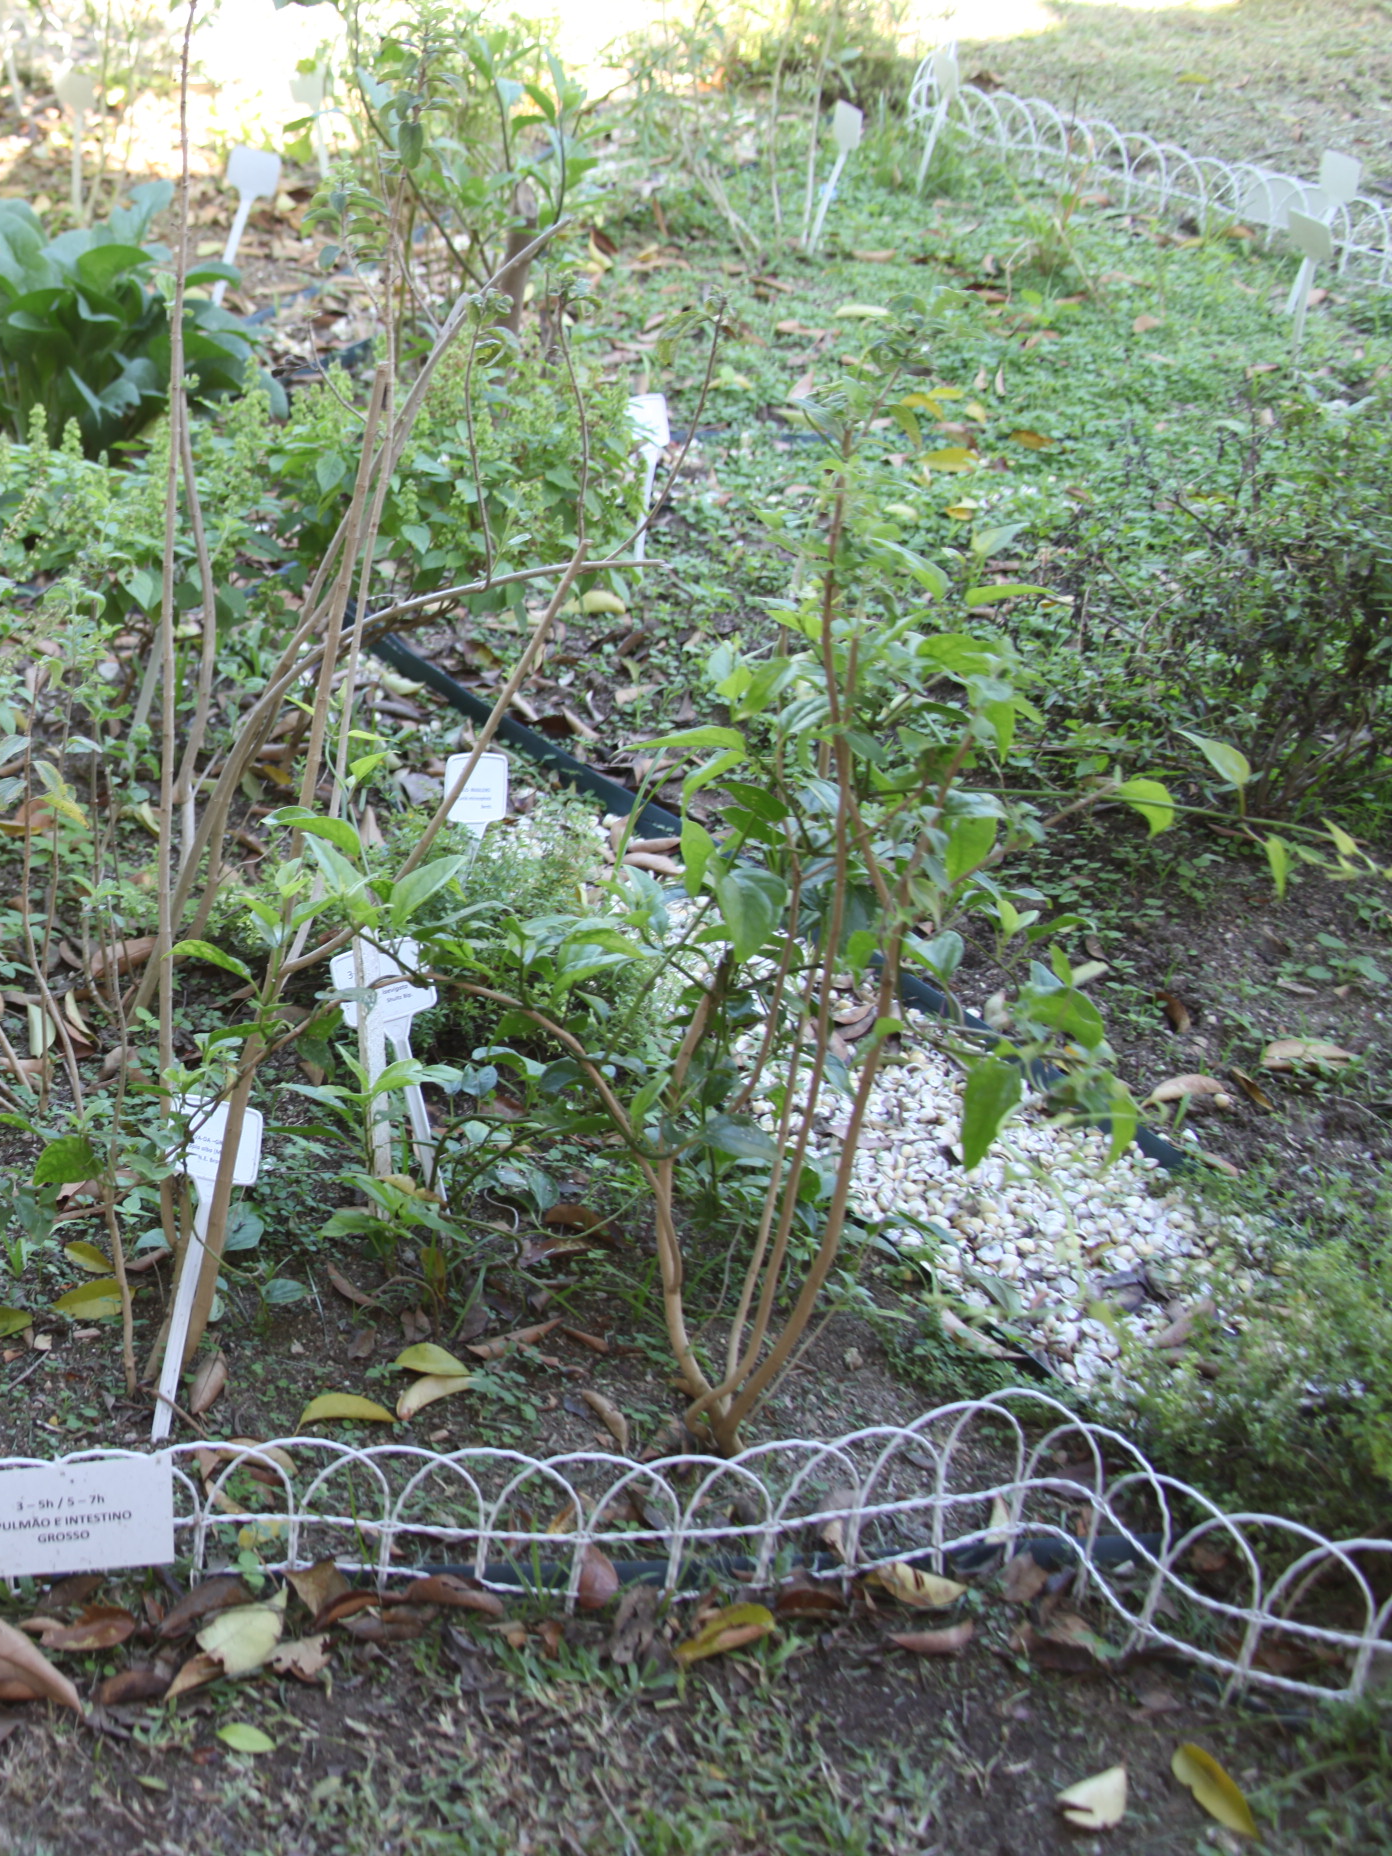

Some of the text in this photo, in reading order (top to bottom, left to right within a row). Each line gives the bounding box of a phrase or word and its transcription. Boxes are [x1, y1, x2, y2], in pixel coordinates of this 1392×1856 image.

[16, 1501, 24, 1512] 3
[38, 1498, 54, 1510] 5h
[67, 1496, 75, 1508] 5
[89, 1493, 105, 1505] 7h
[54, 1516, 62, 1528] E
[65, 1509, 133, 1526] INTESTINO
[37, 1529, 91, 1544] GROSSO
